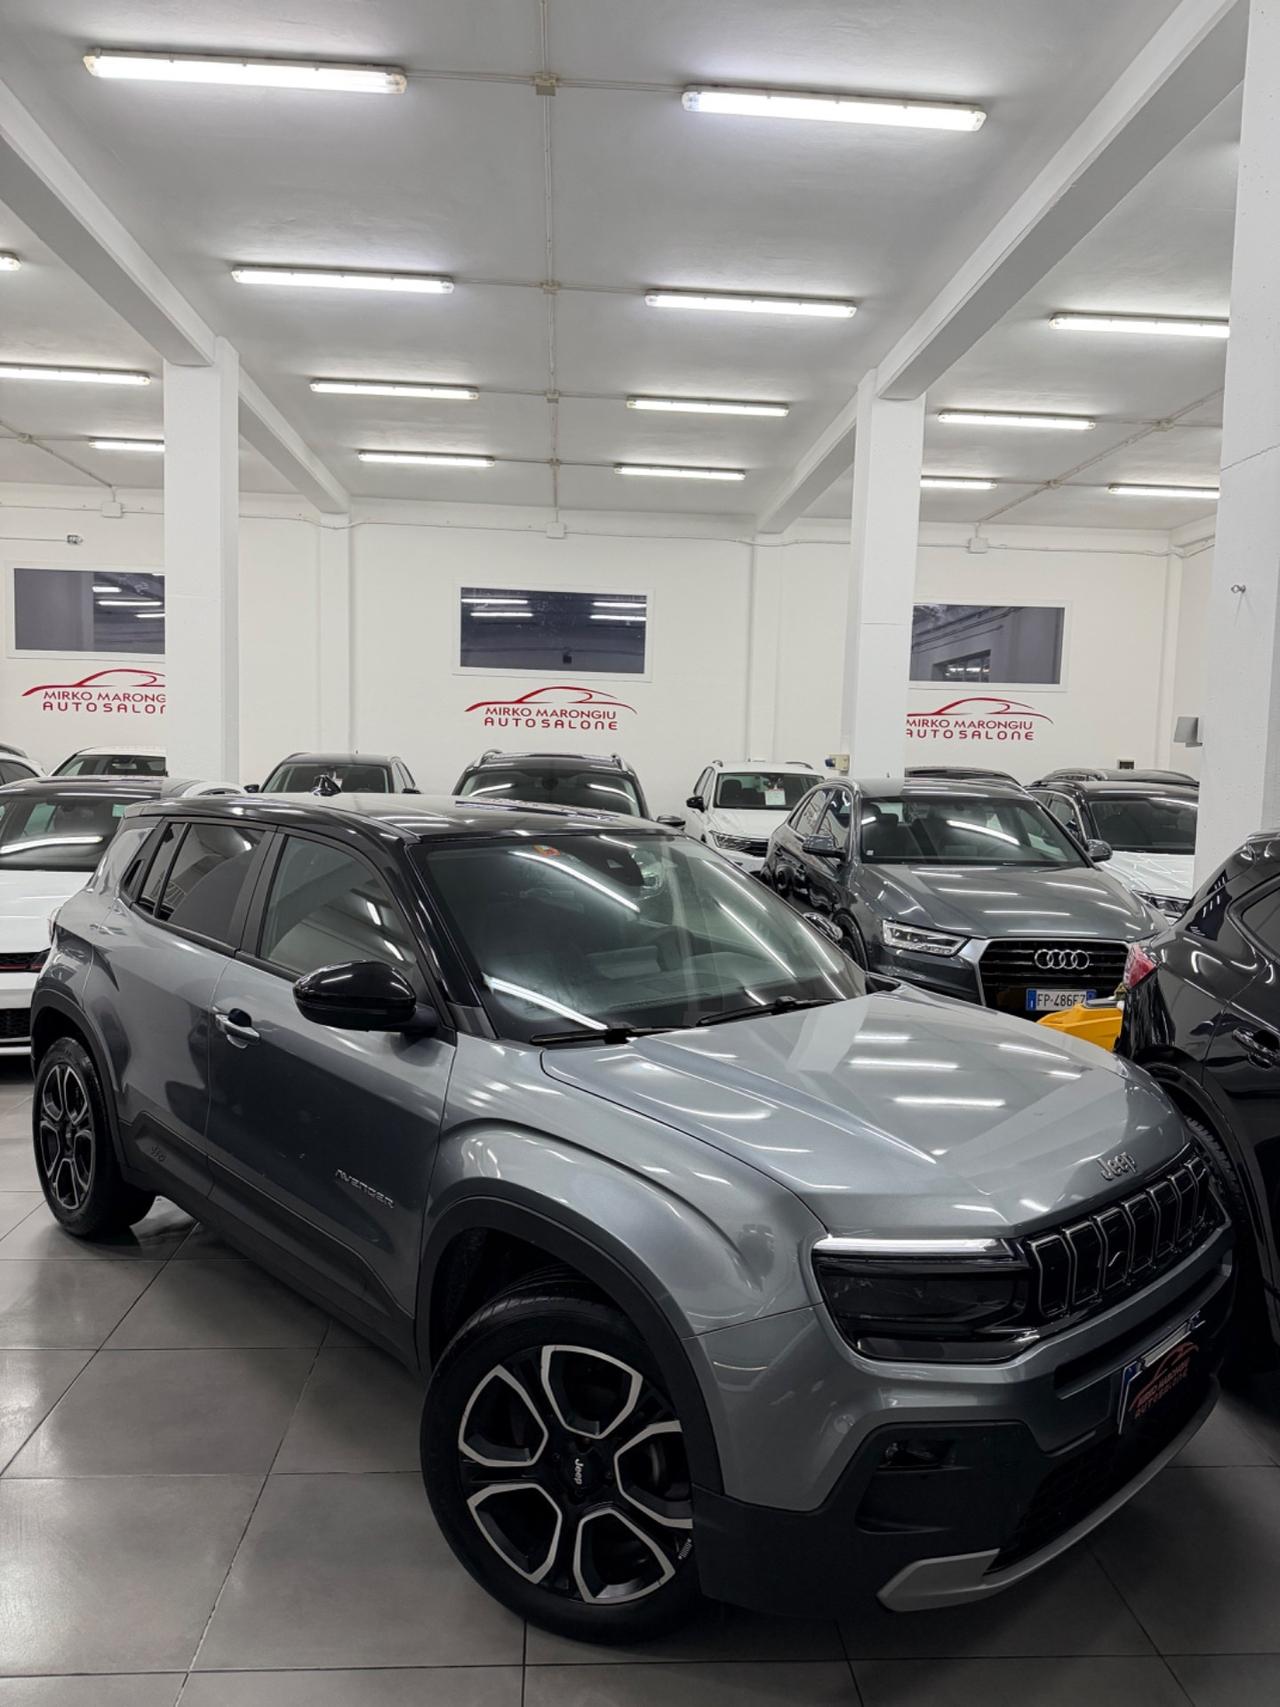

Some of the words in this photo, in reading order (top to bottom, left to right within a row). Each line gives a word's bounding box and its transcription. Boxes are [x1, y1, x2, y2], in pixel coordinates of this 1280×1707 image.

[43, 691, 93, 701] MIRKO
[485, 707, 532, 717] MIRKO
[535, 709, 616, 720] MARONGIU
[484, 716, 618, 731] AUTOSALONE
[906, 719, 950, 728] MIRKO
[953, 720, 1033, 730] MARONGIU
[906, 728, 1034, 741] AUTOSALONE
[1097, 1151, 1136, 1181] Jeep
[574, 1458, 584, 1485] Jeep
